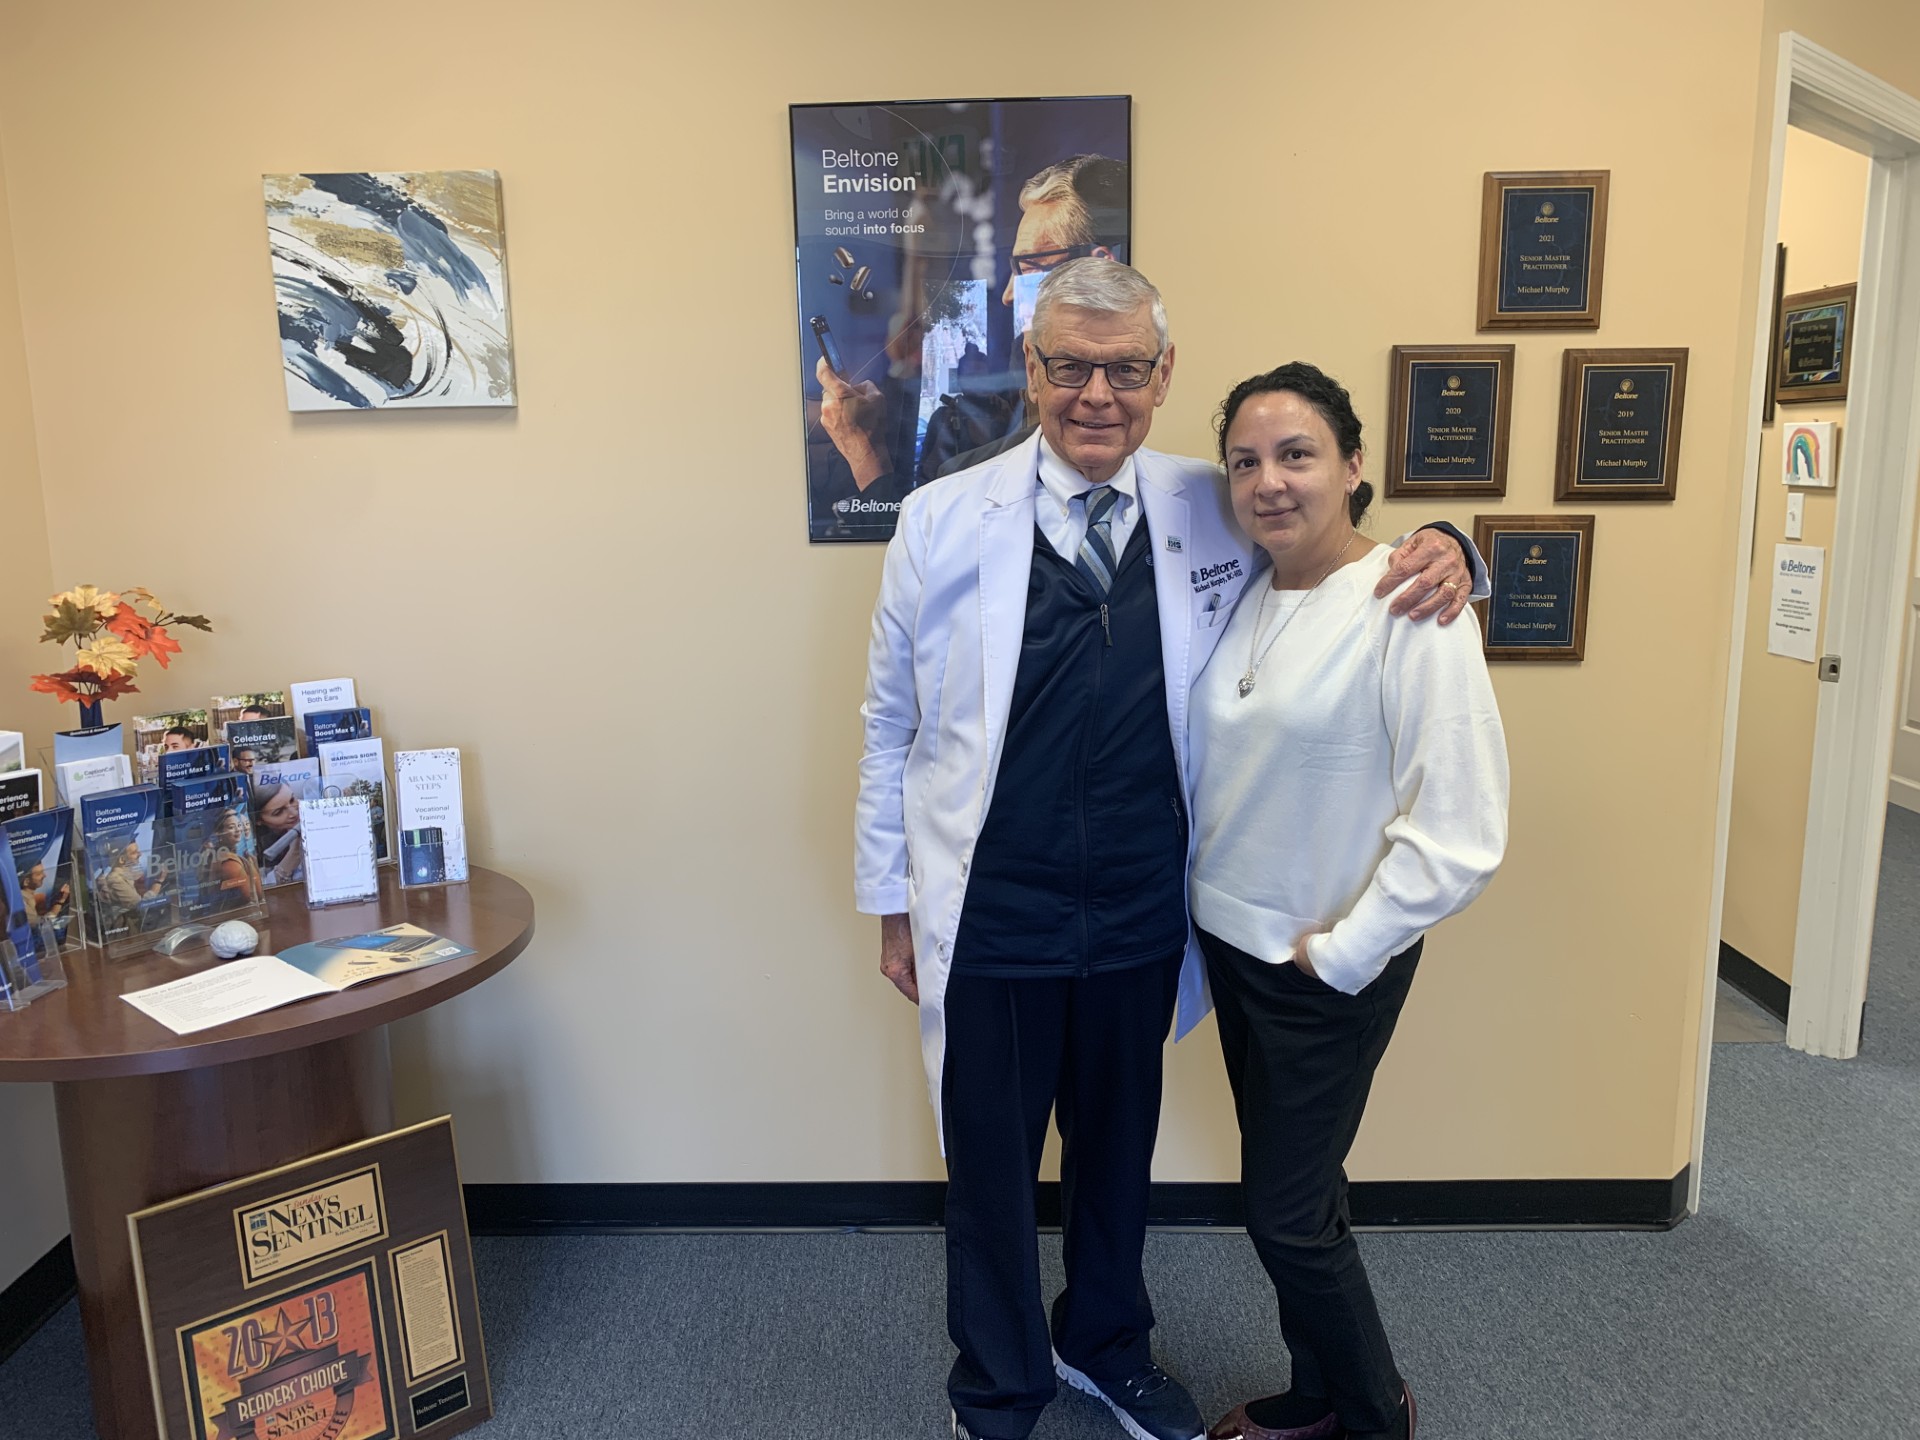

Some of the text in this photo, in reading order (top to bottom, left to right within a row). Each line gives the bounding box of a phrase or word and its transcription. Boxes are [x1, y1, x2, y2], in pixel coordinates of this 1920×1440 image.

[822, 149, 899, 168] Beltone
[825, 207, 913, 222] Bring a world of
[825, 223, 925, 236] sound into focus
[1544, 286, 1570, 294] Murphy
[1445, 407, 1462, 415] 2020
[1451, 456, 1476, 464] Murphy
[1595, 459, 1648, 468] Michael Murphy
[850, 499, 901, 513] Beltone
[1523, 557, 1548, 565] Beltone
[1200, 559, 1239, 581] Beltone
[1787, 560, 1816, 575] Beltone
[1194, 582, 1210, 593] Michael
[1532, 622, 1557, 630] Murphy
[301, 686, 342, 697] Hearing with
[307, 694, 339, 704] Both Ears
[313, 723, 337, 731] Beltone
[233, 733, 276, 744] Celebrate
[314, 729, 335, 737] Boost
[166, 762, 191, 771] Beltone
[166, 770, 187, 778] Boost
[188, 767, 203, 775] Max
[407, 773, 448, 783] ABA NEXT
[259, 771, 311, 786] Belcare
[415, 782, 442, 791] STEPS
[185, 791, 210, 801] Beltone
[7, 802, 15, 811] of
[16, 800, 30, 809] Life
[185, 799, 207, 809] Boost
[208, 796, 222, 806] Max
[95, 807, 121, 817] Beltone
[415, 805, 450, 813] Vocational
[96, 811, 139, 825] Commence
[419, 813, 446, 822] Training
[146, 846, 230, 878] Beltone
[268, 1195, 341, 1234] NEWS
[252, 1204, 373, 1258] SENTINEL
[301, 1360, 348, 1396] CHOICE
[416, 1389, 465, 1415] Beltone Tennessee
[275, 1402, 315, 1426] NEWS
[267, 1408, 328, 1440] SENTINEL
